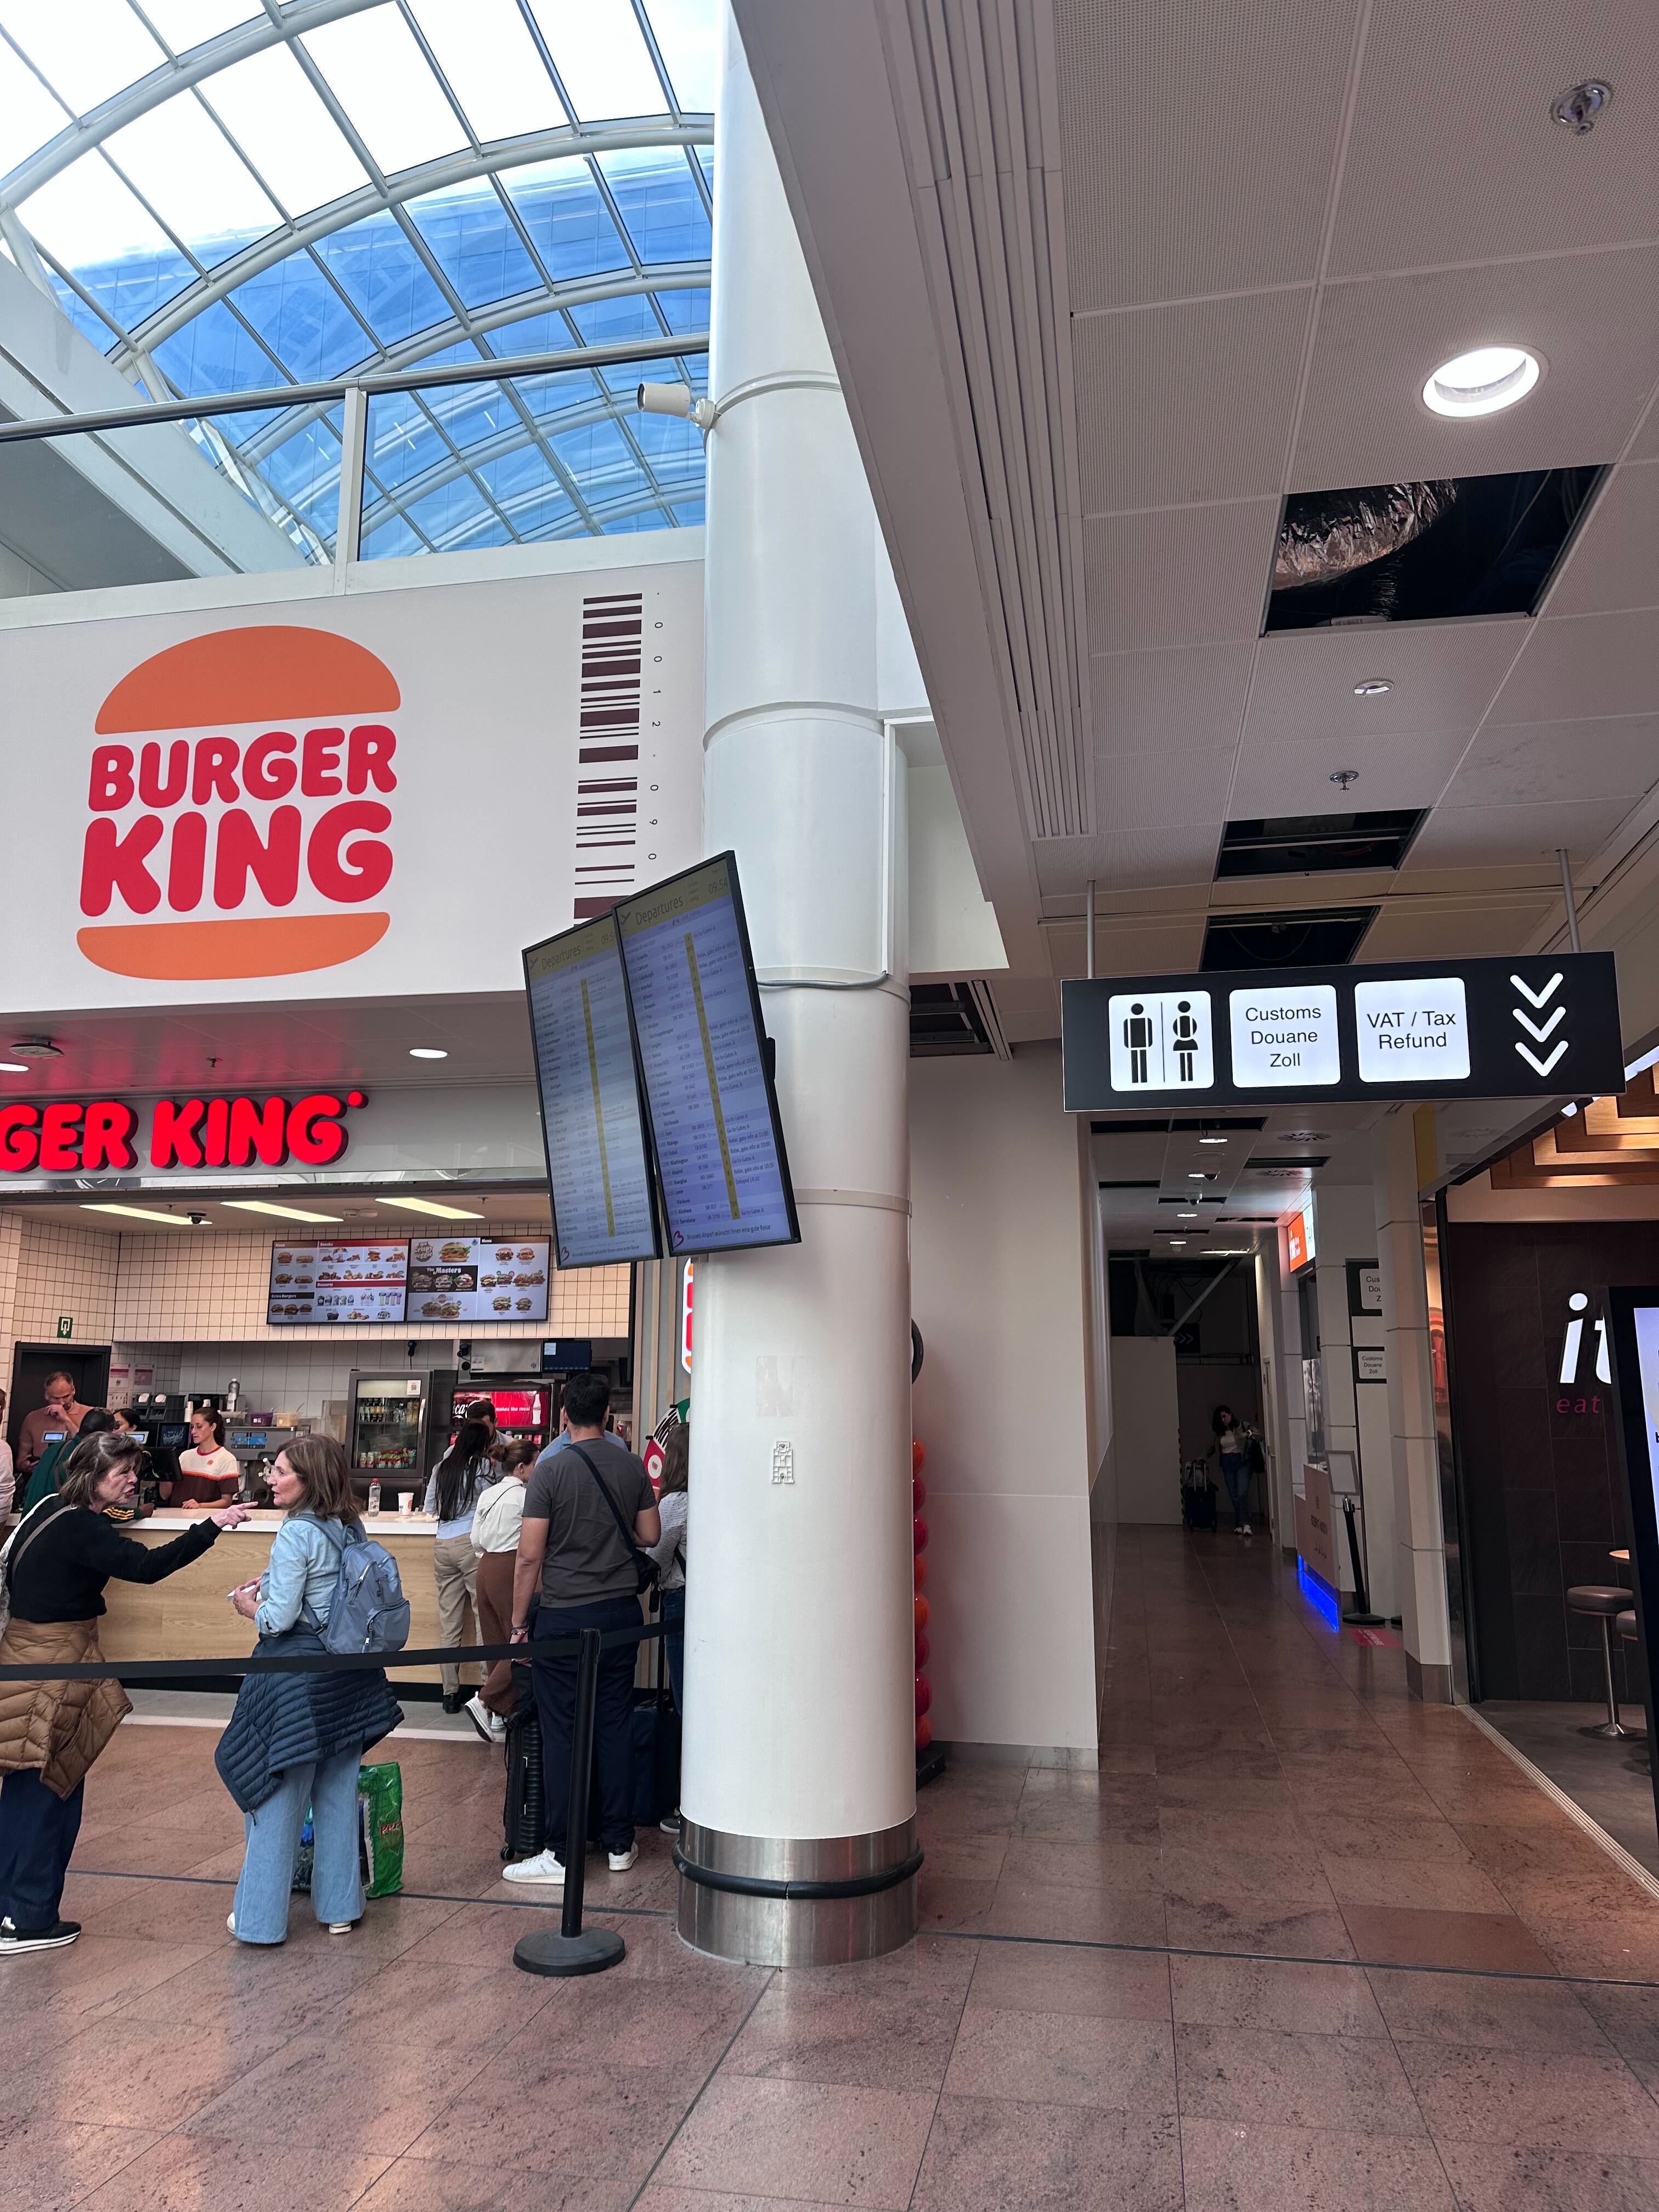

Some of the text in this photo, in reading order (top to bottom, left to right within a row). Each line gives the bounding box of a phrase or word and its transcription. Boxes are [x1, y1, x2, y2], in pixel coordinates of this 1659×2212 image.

[89, 725, 397, 812] BURGER
[80, 800, 393, 917] KING
[636, 896, 683, 925] Departures
[708, 879, 728, 894] 09:54
[541, 945, 580, 970] Departures
[601, 932, 616, 944] 09:5
[1245, 1007, 1321, 1022] Customs
[1367, 1010, 1457, 1029] VAT / Tax
[1251, 1030, 1318, 1045] Douane
[1379, 1031, 1447, 1050] Refund
[1270, 1053, 1301, 1068] Zoll
[150, 1094, 342, 1167] KING
[1556, 1396, 1600, 1414] eat
